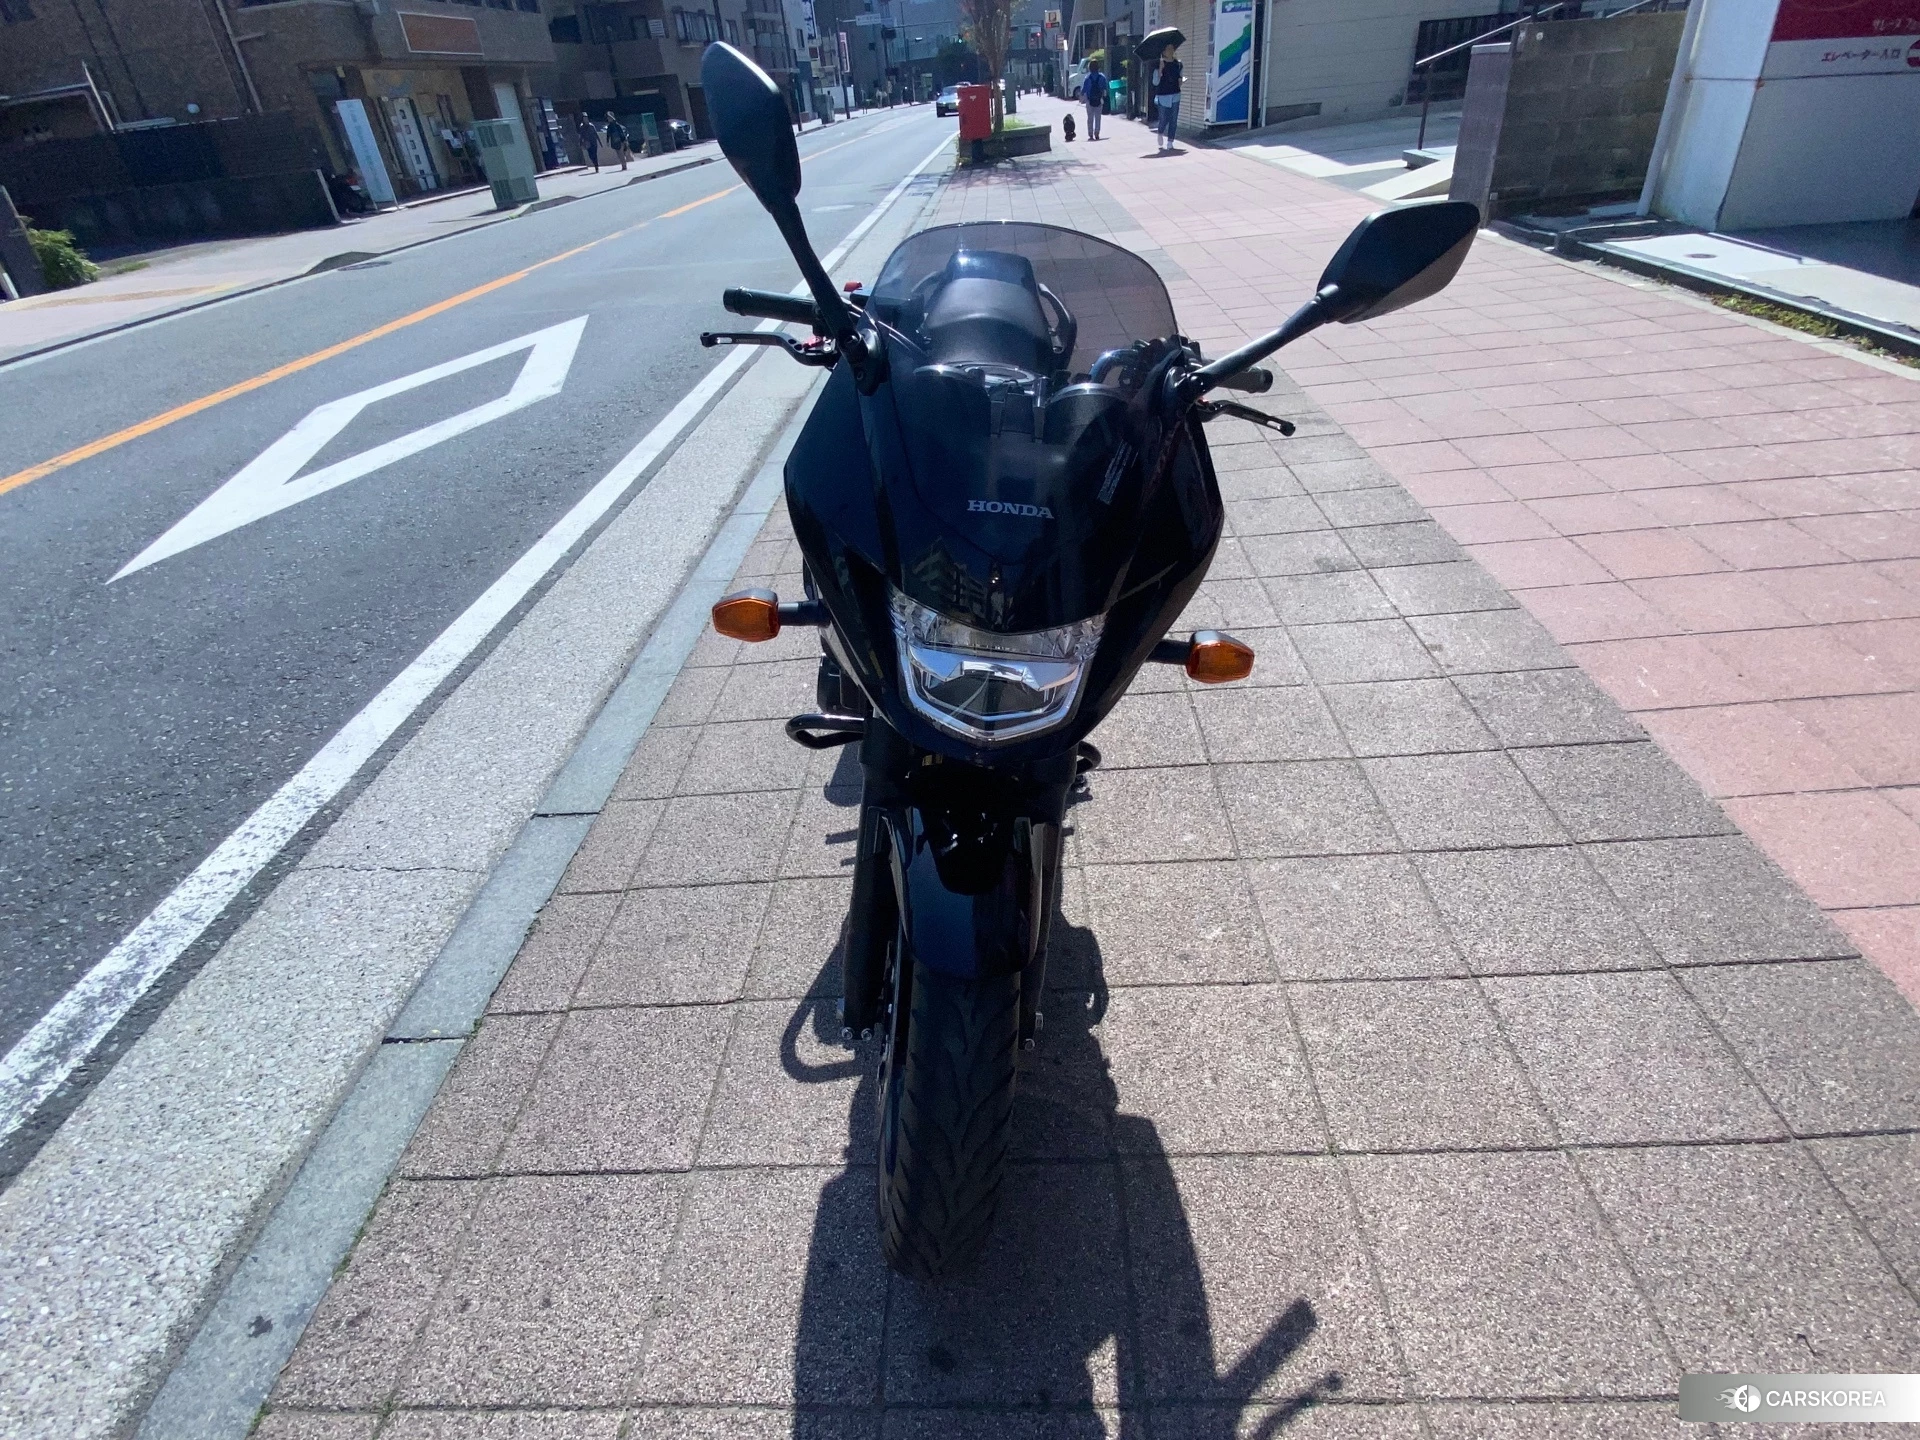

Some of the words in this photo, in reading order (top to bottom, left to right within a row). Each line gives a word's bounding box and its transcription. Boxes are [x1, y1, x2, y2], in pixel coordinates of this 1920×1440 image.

[1821, 48, 1901, 61] エレベーター入口
[966, 500, 1055, 519] HONDA
